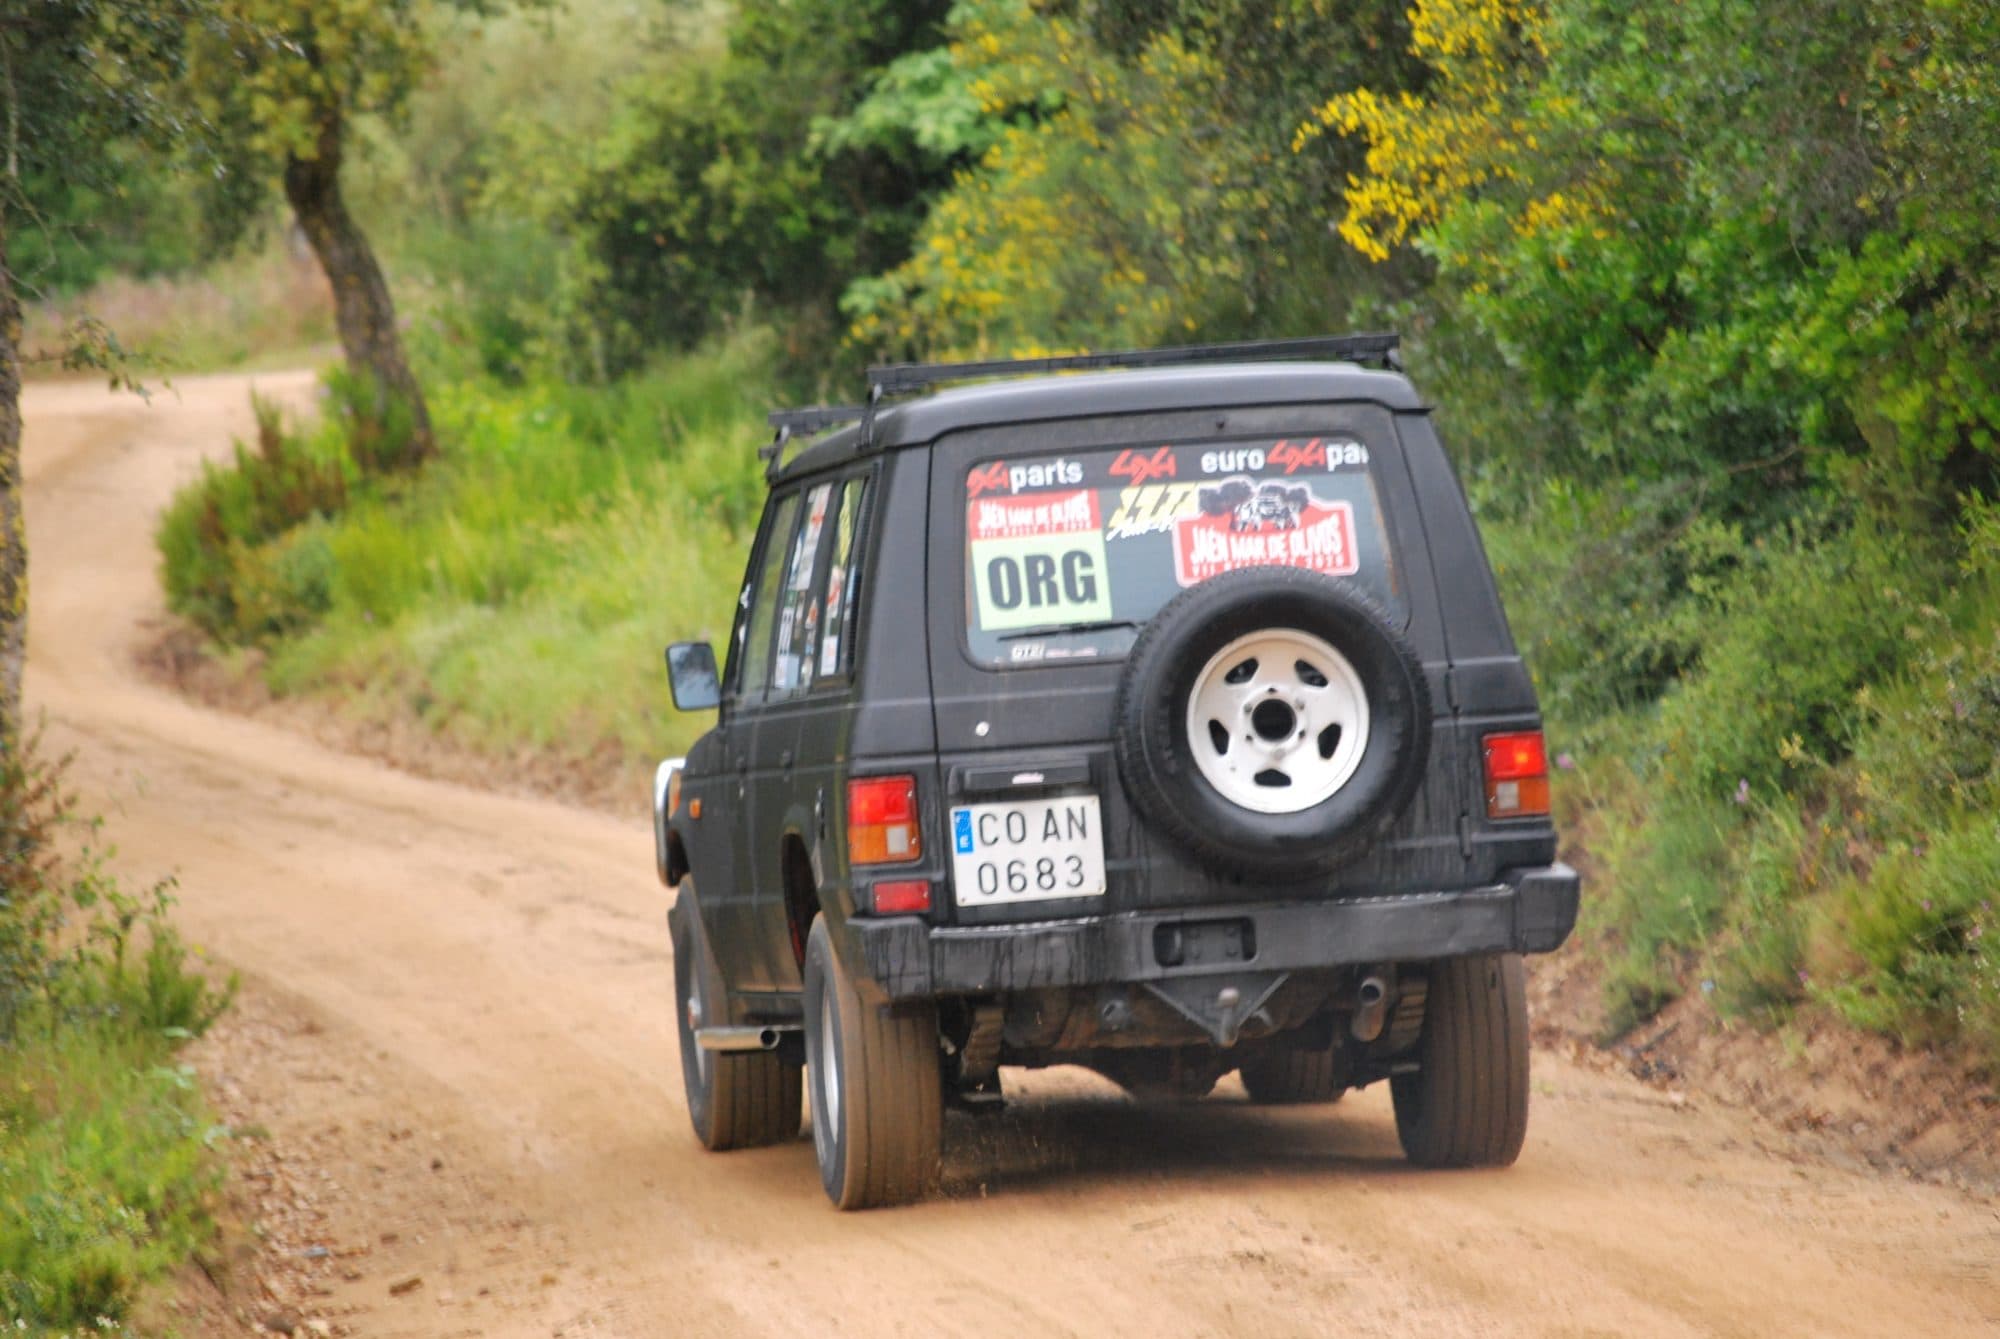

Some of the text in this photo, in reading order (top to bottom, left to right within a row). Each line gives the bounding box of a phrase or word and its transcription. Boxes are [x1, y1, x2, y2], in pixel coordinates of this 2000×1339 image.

[987, 550, 1097, 610] ORG
[978, 805, 1087, 846] CO AN
[977, 855, 1084, 895] 0683
